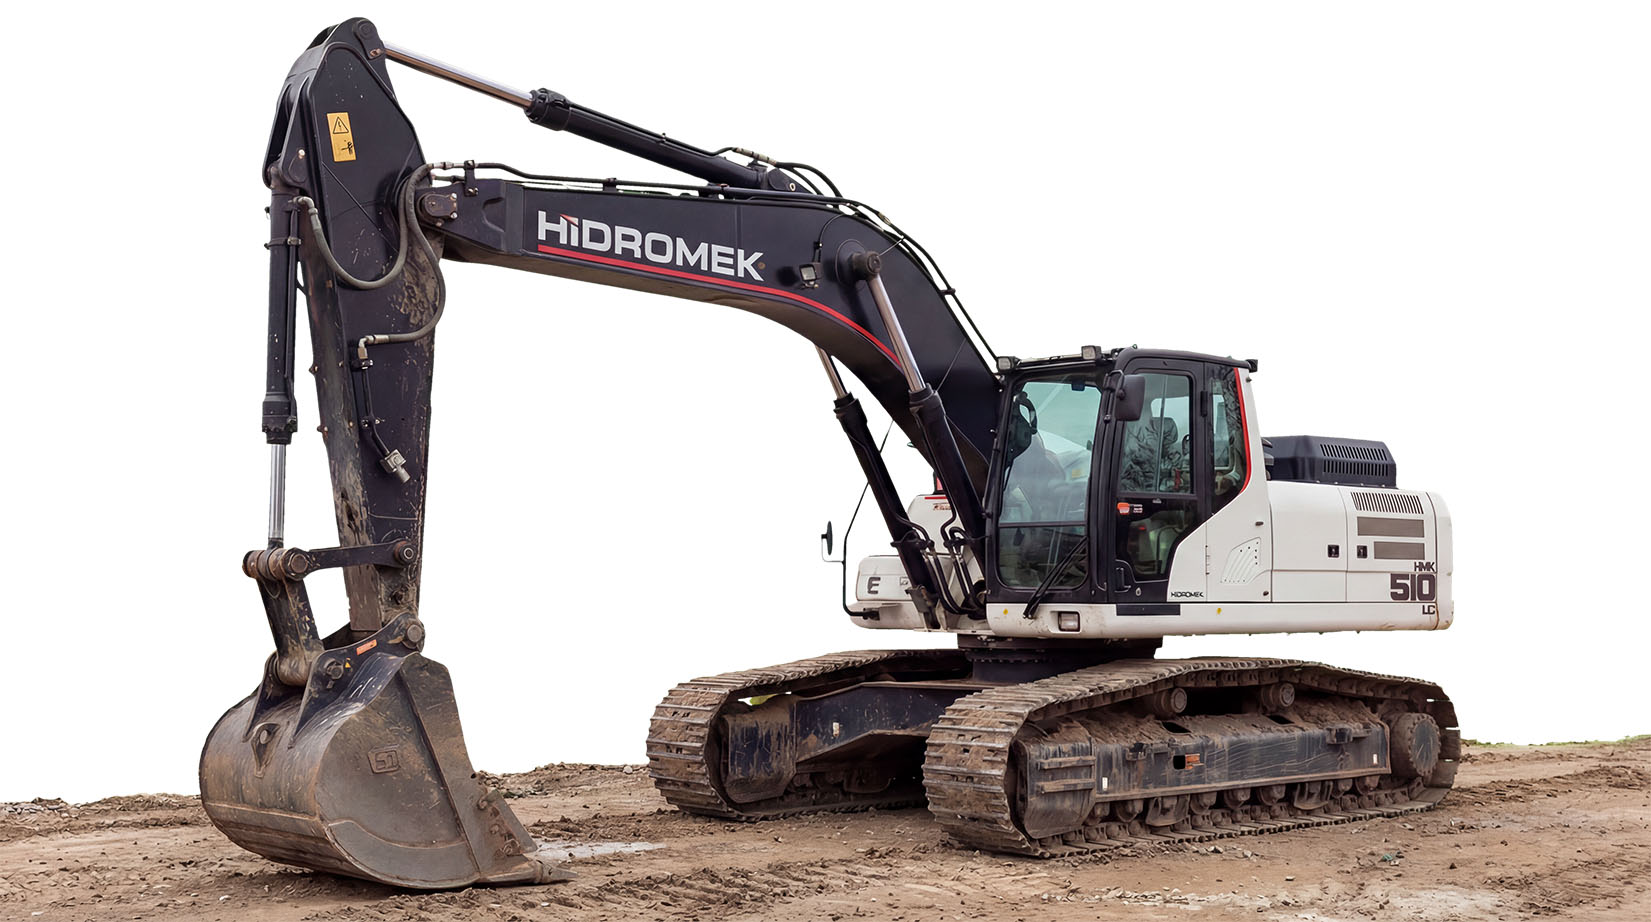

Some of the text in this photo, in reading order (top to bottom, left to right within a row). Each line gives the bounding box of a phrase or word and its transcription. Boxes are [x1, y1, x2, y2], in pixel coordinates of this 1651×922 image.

[1414, 561, 1435, 572] HMK
[1390, 573, 1436, 601] 510
[1422, 604, 1436, 615] LC
